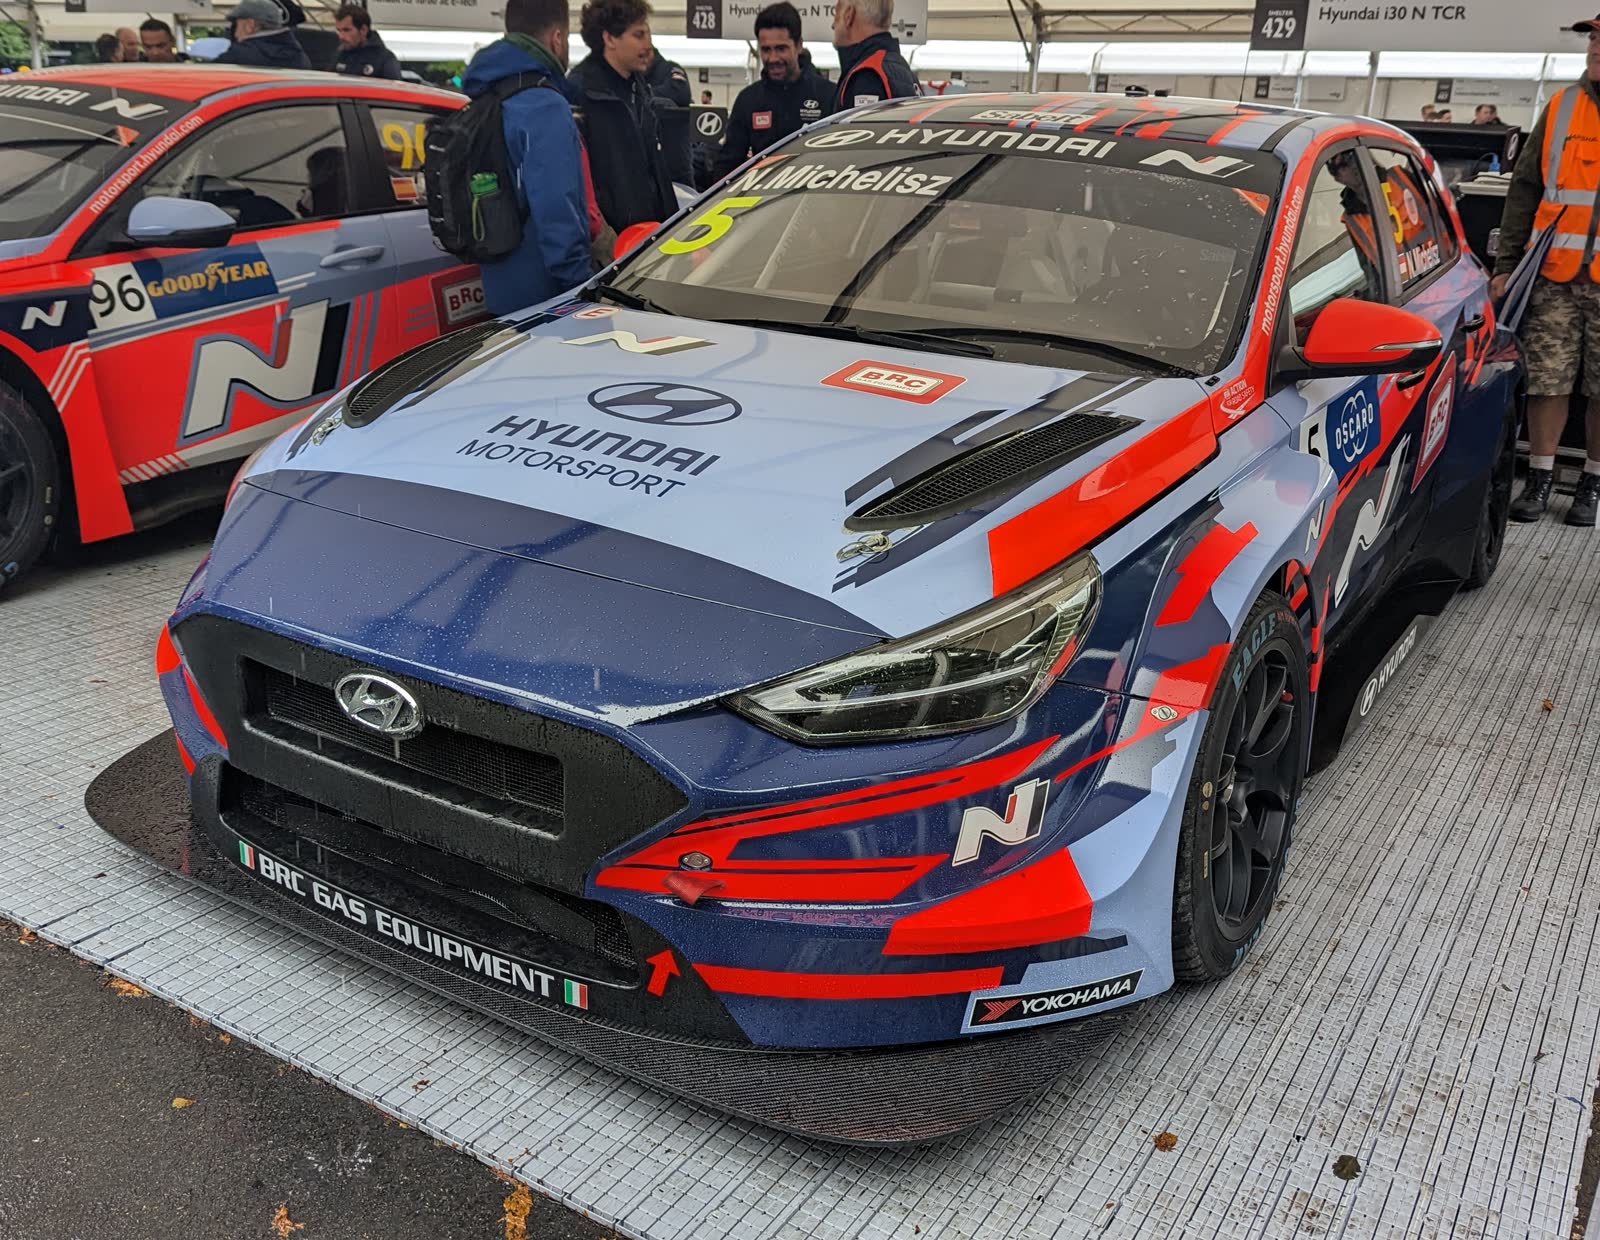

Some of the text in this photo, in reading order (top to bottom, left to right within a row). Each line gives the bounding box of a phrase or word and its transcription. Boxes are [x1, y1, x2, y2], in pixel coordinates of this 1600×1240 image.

[692, 12, 716, 30] 428
[811, 6, 820, 17] N
[1261, 18, 1297, 39] 429
[1319, 6, 1466, 25] Hyundai i30 N TCR
[981, 109, 1083, 123] Sabelt
[89, 115, 204, 214] motorsport.hyundai.com
[875, 128, 1118, 159] HYUNDAI
[727, 164, 953, 197] N.Michelisz
[658, 196, 762, 255] 5
[1381, 182, 1404, 244] 5
[1261, 185, 1304, 336] motorsport.hyundai.com
[90, 274, 146, 318] 96
[449, 287, 484, 311] BRC
[861, 371, 926, 388] BRC
[487, 415, 721, 477] HYUNDAI
[1335, 402, 1374, 450] OSCARO
[456, 439, 686, 498] MOTORSPORT
[1231, 611, 1277, 691] EAGLE
[1377, 624, 1419, 693] HYUNDAI
[258, 852, 555, 998] BRC GAS EQUIPMENT
[1021, 978, 1131, 1015] YOKOHAMA
